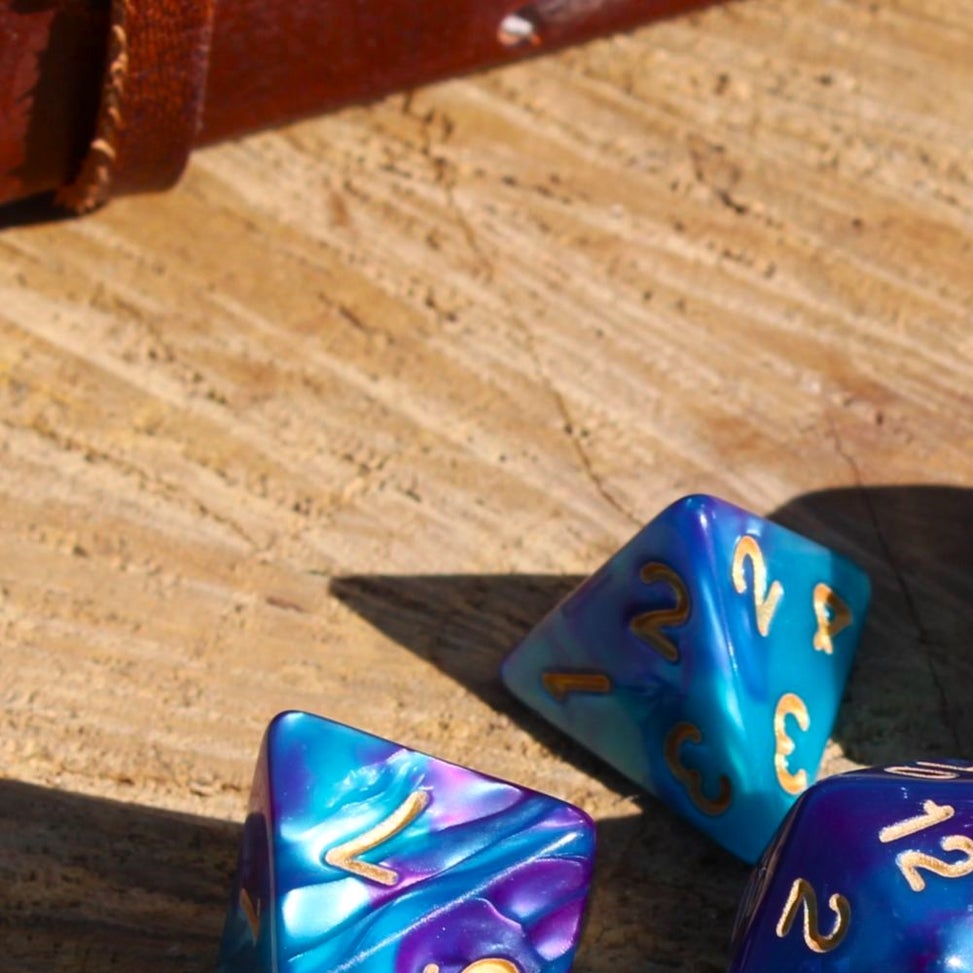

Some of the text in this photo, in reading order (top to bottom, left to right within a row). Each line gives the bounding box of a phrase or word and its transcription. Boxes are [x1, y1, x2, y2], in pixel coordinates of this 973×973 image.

[629, 562, 690, 662] 2
[733, 535, 784, 637] 2
[812, 583, 853, 655] 4
[664, 722, 733, 816] 3
[774, 693, 810, 795] 3
[776, 878, 851, 954] 2
